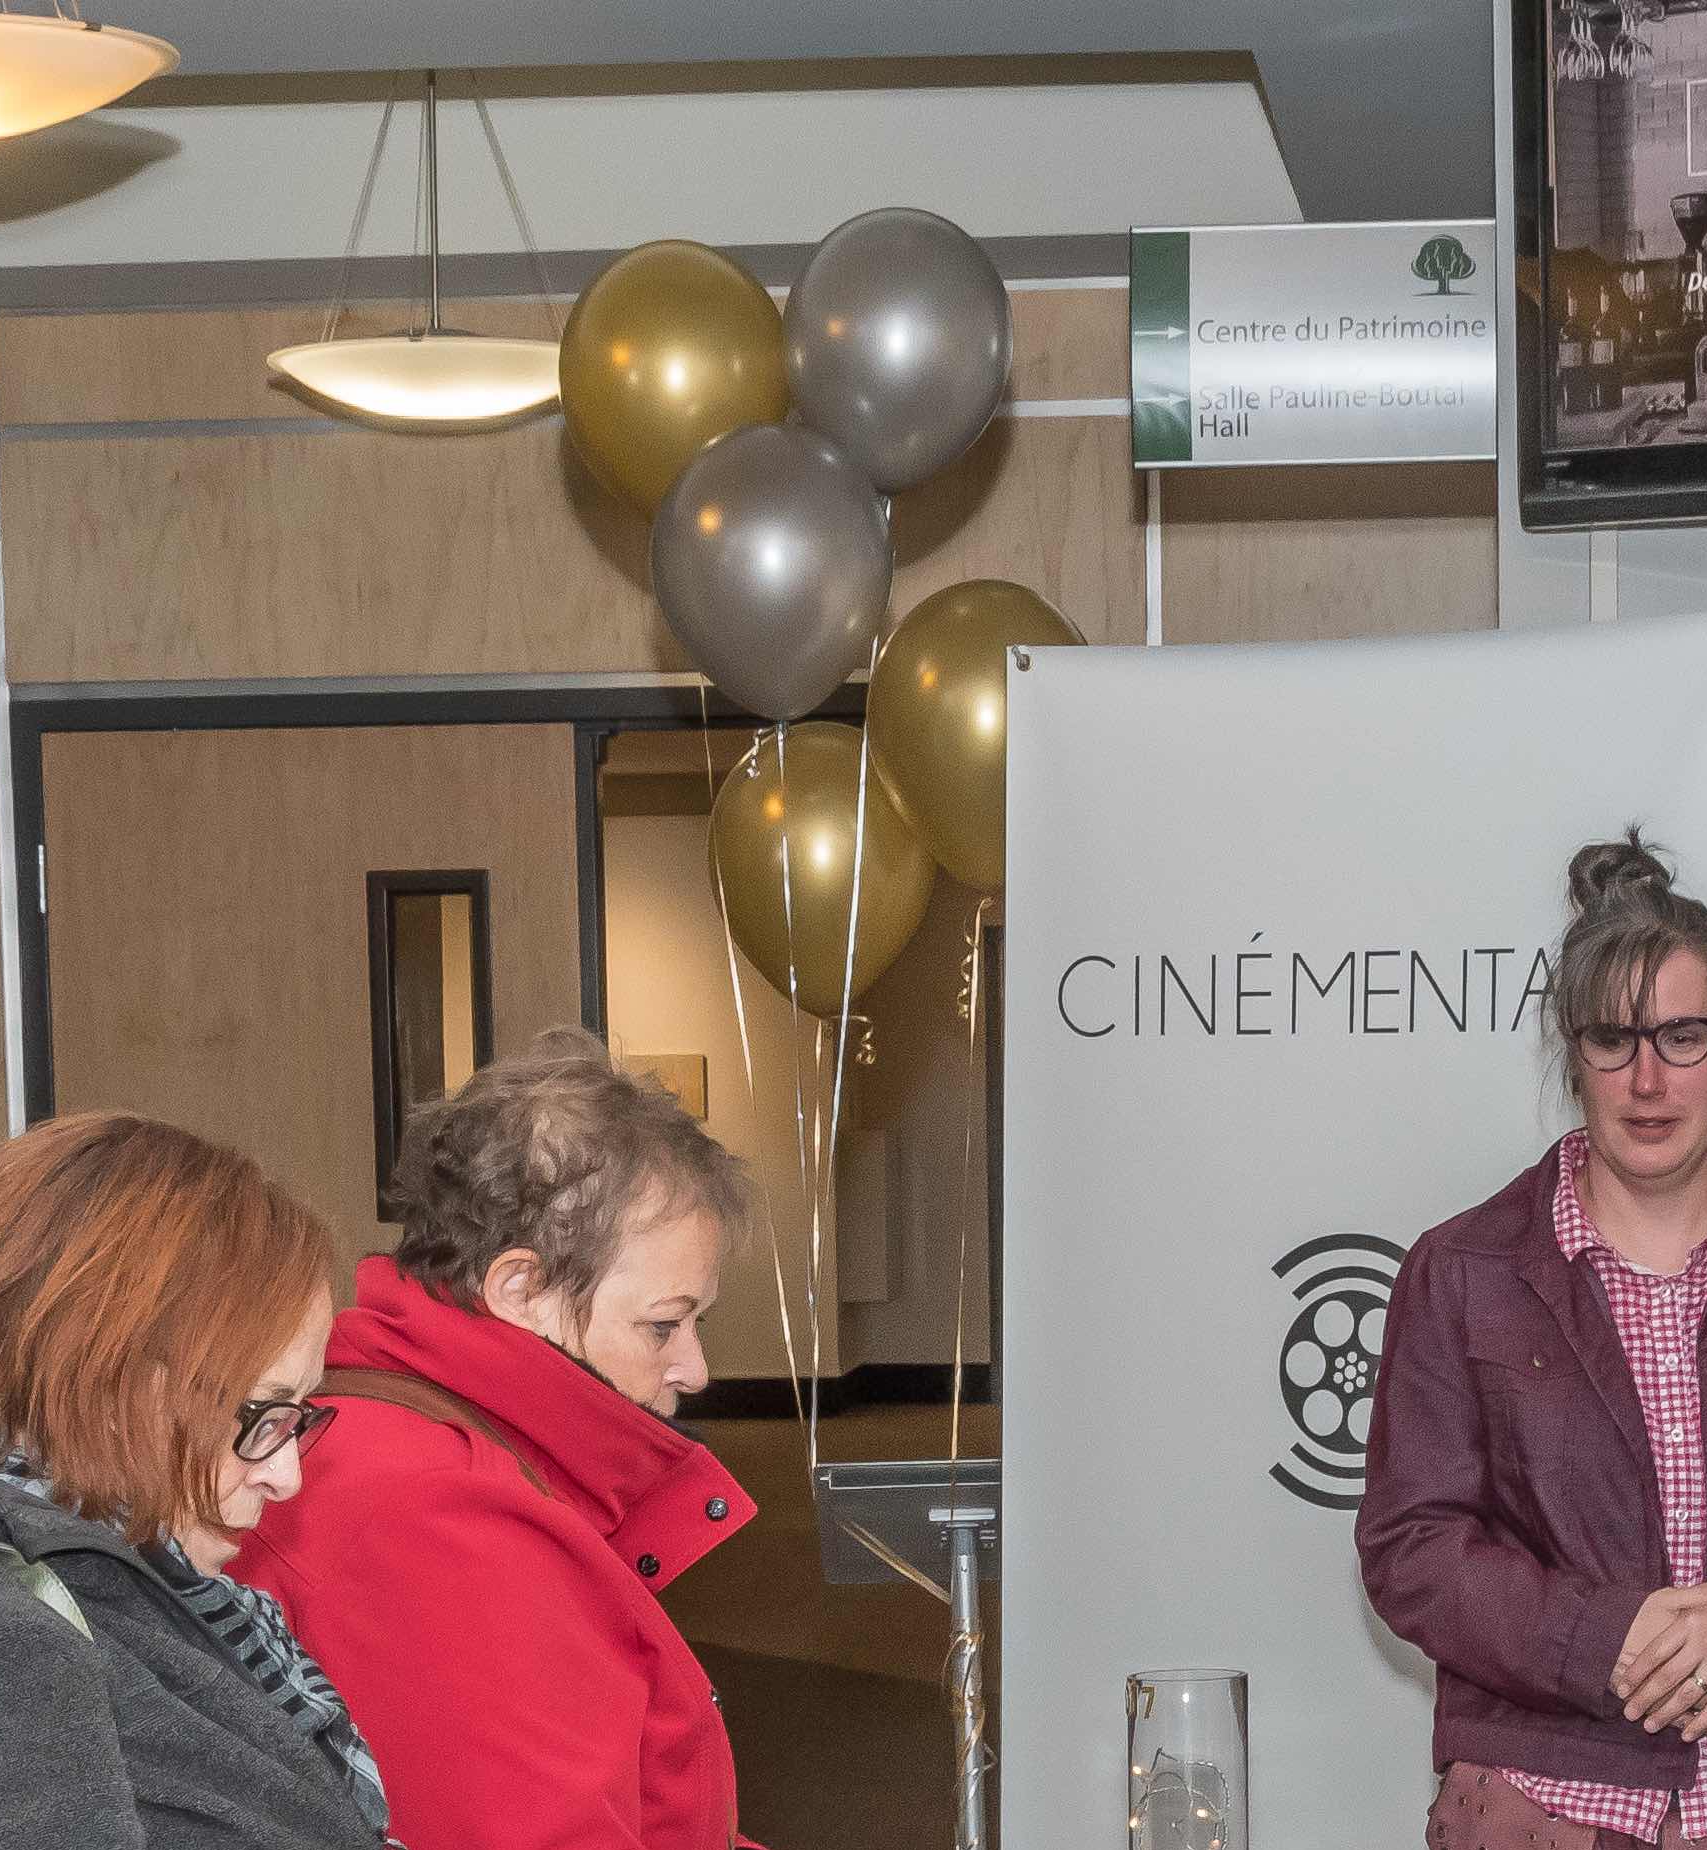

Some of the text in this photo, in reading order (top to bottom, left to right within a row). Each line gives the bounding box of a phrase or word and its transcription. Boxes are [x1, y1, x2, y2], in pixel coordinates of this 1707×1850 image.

[1197, 314, 1486, 344] Centre du Patrimoine
[1198, 385, 1260, 410] Salle
[1199, 413, 1249, 438] Hall
